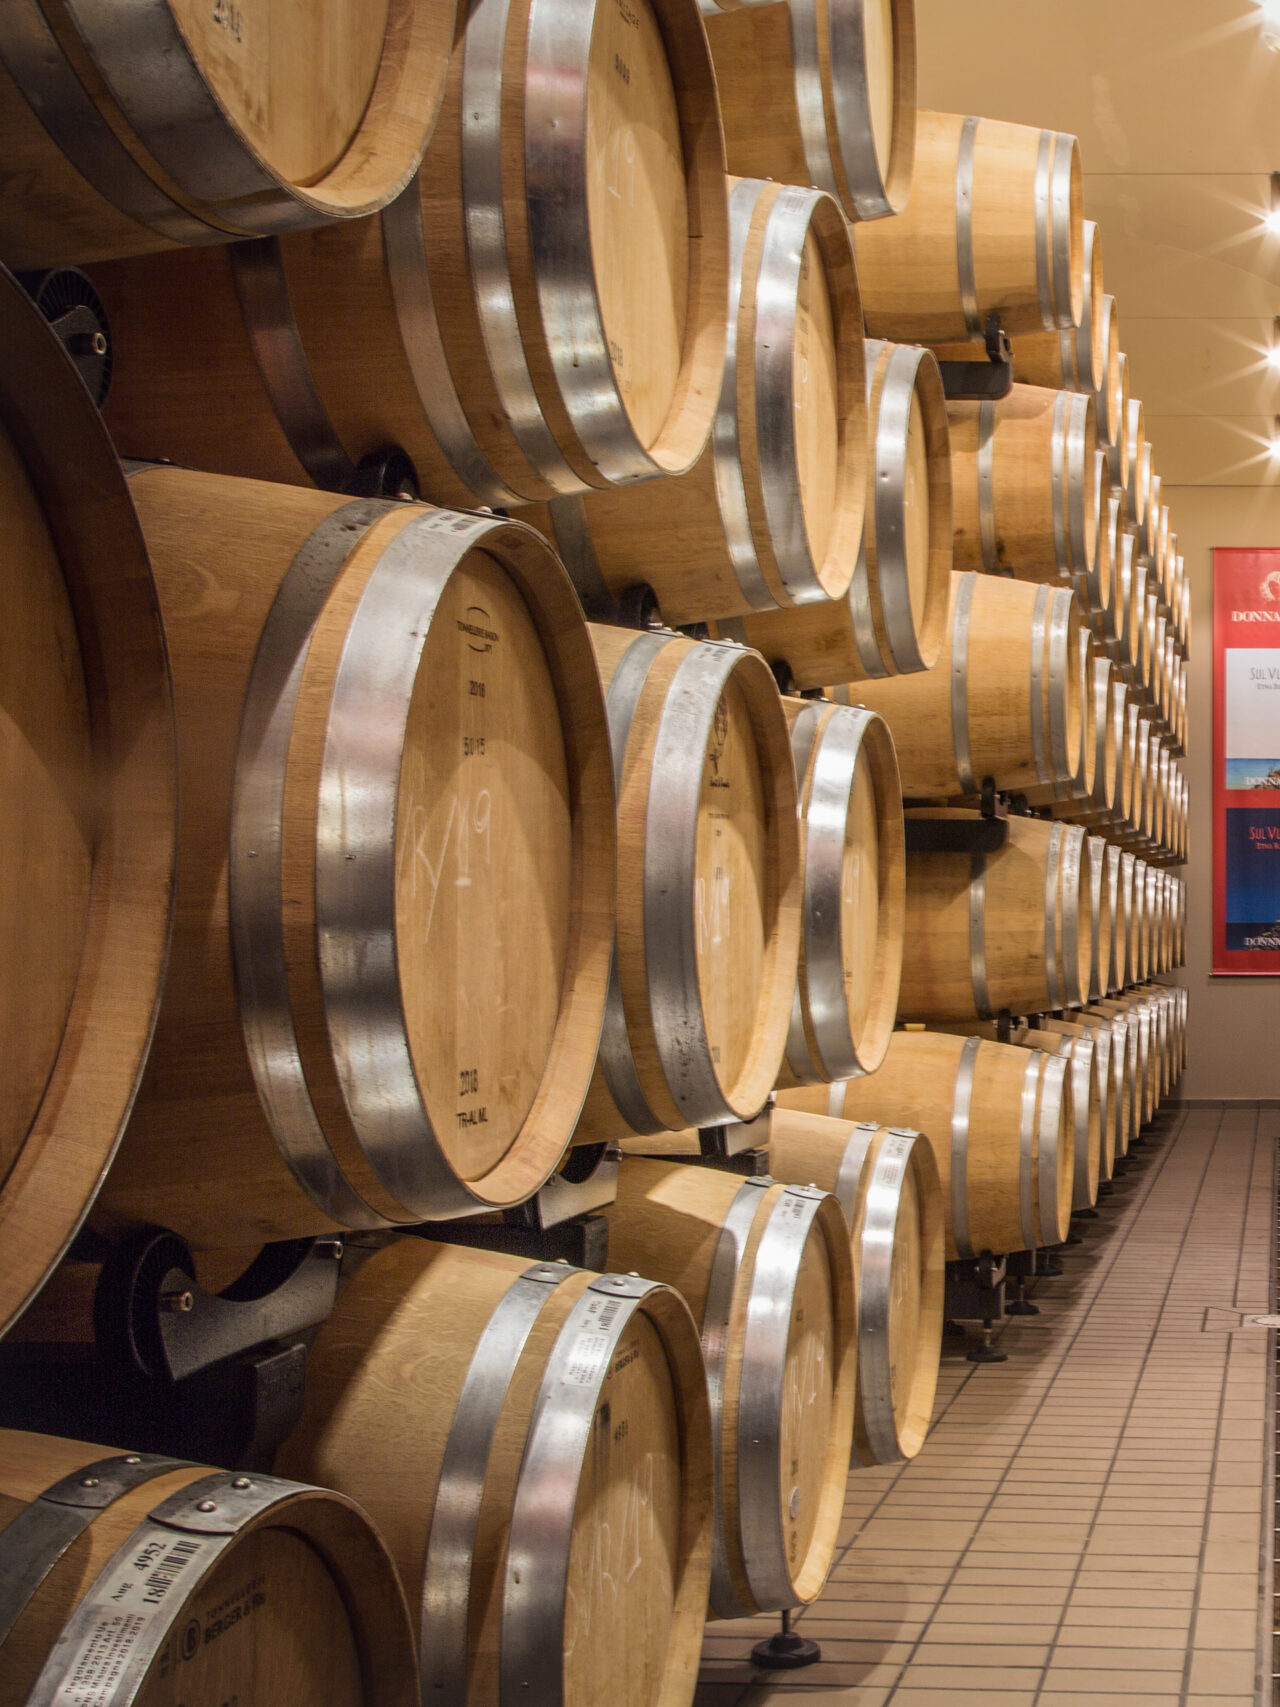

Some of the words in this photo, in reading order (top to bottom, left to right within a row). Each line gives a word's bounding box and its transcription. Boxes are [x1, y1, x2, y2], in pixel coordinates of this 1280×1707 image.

[111, 1582, 134, 1602] Aug
[132, 1541, 167, 1571] 4952
[142, 1588, 168, 1605] 18
[64, 1632, 104, 1694] Regolamento
